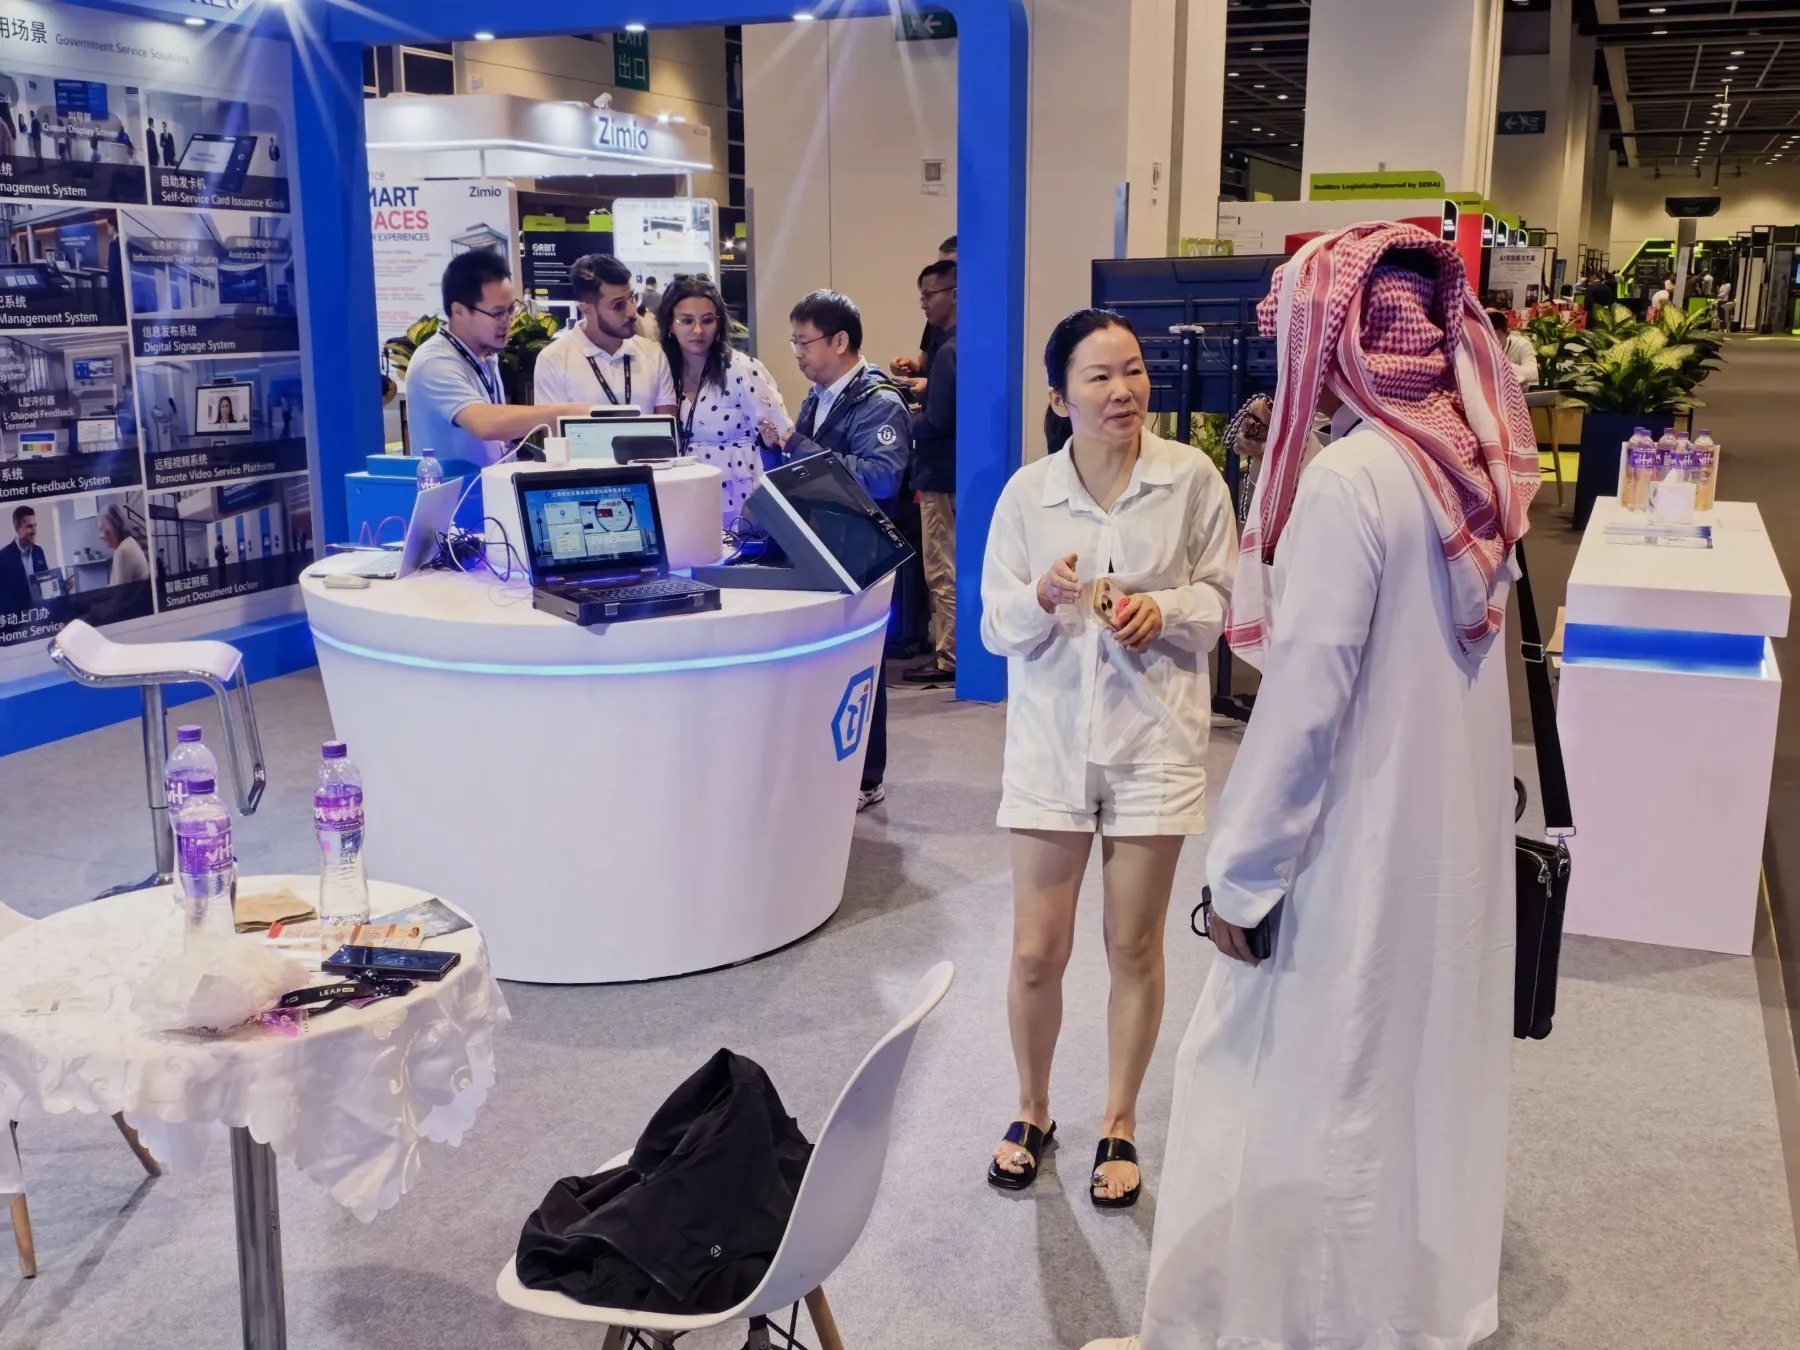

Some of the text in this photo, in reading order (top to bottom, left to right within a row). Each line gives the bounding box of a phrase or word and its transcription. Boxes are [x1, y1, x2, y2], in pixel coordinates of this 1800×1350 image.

[0, 16, 47, 44] 用场景
[55, 34, 113, 52] Government
[117, 43, 148, 58] Service
[618, 53, 645, 82] 出口
[68, 124, 95, 137] Display
[598, 116, 649, 150] Zimio
[53, 183, 87, 198] System
[161, 175, 206, 190] 自动发卡机
[161, 191, 210, 204] Self-Service
[211, 194, 230, 205] Card
[231, 196, 264, 208] Issuance
[468, 185, 502, 198] Zimio
[378, 232, 430, 242] EXPERIENCES
[532, 243, 556, 252] ORBIT
[132, 252, 174, 264] Information
[0, 311, 99, 327] Management System
[142, 325, 197, 338] 信息发布系统
[143, 339, 236, 355] Digital Signage System
[3, 407, 74, 422] L-Shaped Feedback
[4, 420, 37, 431] Terminal
[154, 453, 208, 471] 远程视频系统
[156, 472, 187, 485] Remote
[188, 469, 212, 481] Video
[213, 465, 241, 478] Service
[31, 478, 76, 494] Feedback
[77, 476, 111, 490] System
[166, 594, 193, 607] Smart
[192, 585, 233, 602] Document
[0, 621, 65, 642] Home Service
[319, 988, 341, 997] LEAP
